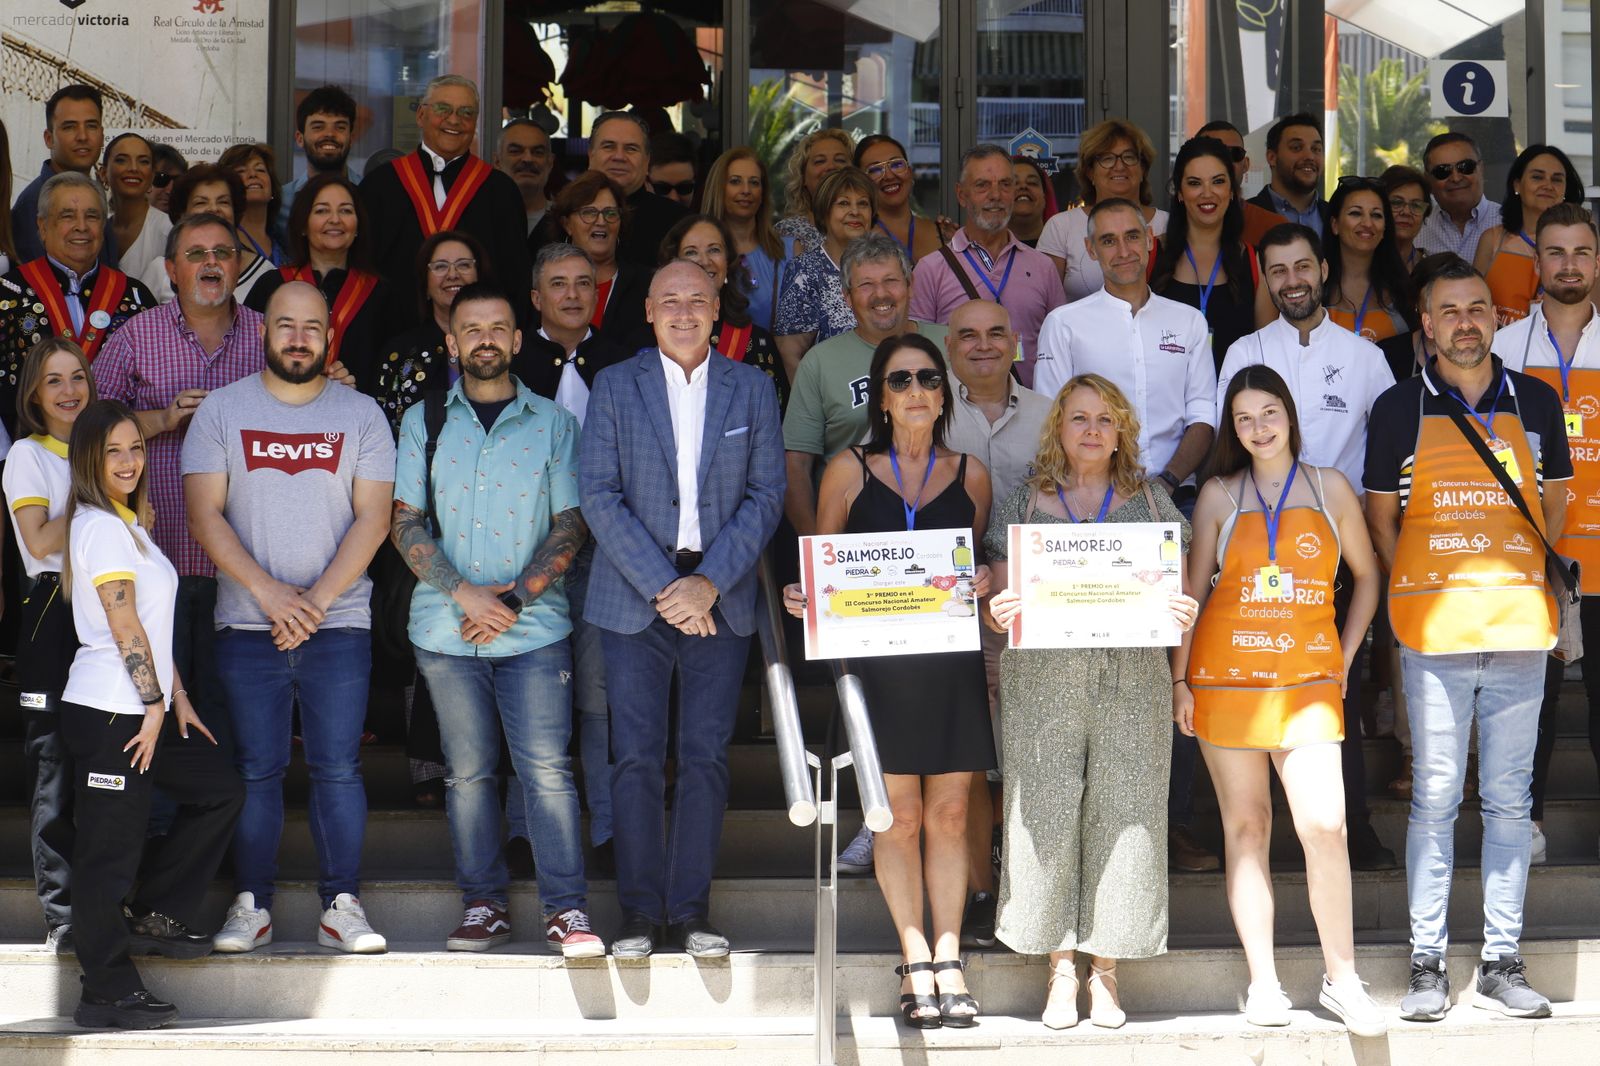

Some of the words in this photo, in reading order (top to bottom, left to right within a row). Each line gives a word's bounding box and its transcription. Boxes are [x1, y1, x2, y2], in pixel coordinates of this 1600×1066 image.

[13, 13, 73, 26] mercado
[77, 14, 129, 26] victoria
[153, 16, 172, 27] Real
[207, 17, 217, 27] de
[219, 18, 227, 28] la
[229, 16, 265, 28] Amistad
[175, 134, 183, 143] el
[185, 134, 222, 144] Mercado
[223, 135, 256, 144] Victoria
[200, 147, 212, 156] de
[213, 147, 221, 156] la
[1434, 509, 1486, 522] Cordobés
[1030, 531, 1045, 555] 3
[1045, 539, 1123, 553] SALMOREJO
[821, 542, 837, 565] 3
[837, 547, 915, 564] SALMOREJO
[1268, 575, 1279, 587] 6
[1239, 606, 1294, 619] Cordobés
